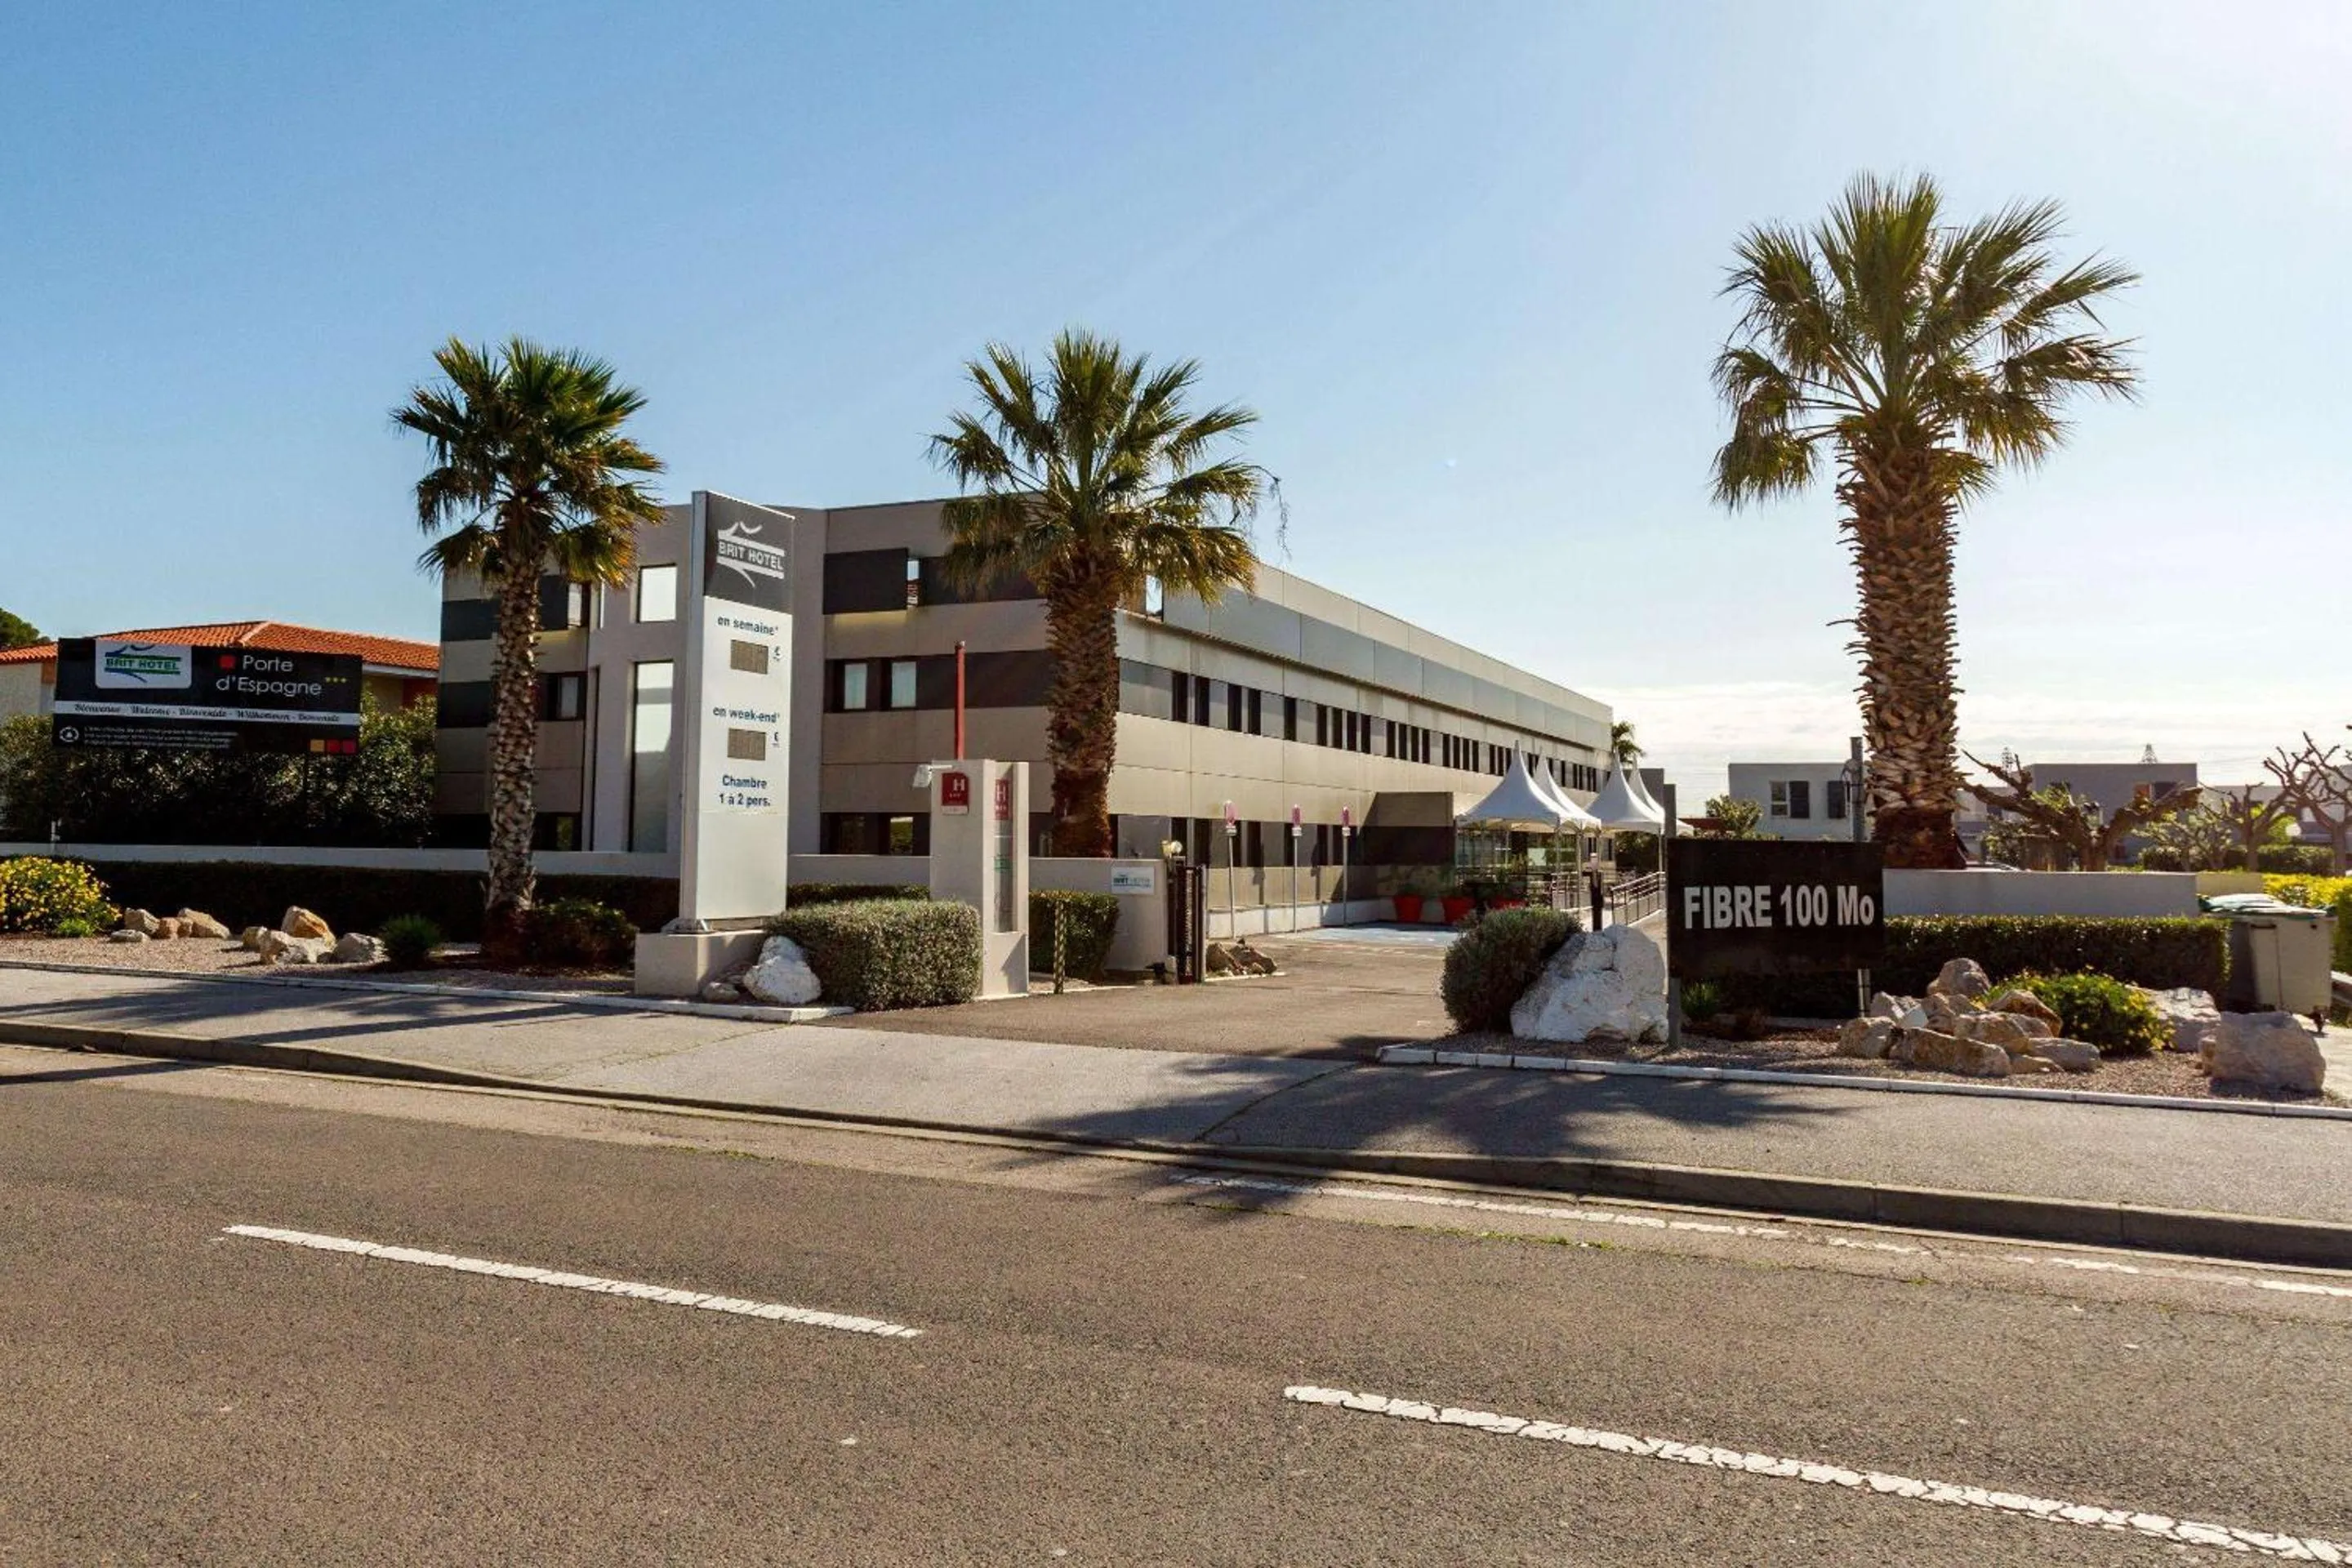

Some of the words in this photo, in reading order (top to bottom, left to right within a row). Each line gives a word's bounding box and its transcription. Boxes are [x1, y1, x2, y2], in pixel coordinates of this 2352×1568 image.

[718, 541, 746, 559] BRIT
[748, 549, 784, 571] HOTEL
[717, 617, 730, 626] en
[105, 657, 136, 668] BRIT
[139, 659, 180, 670] HOTEL
[243, 654, 294, 672] Porte
[216, 675, 322, 697] d'Espagne
[713, 706, 726, 717] en
[722, 774, 768, 789] Chambre
[953, 778, 965, 791] H
[719, 793, 724, 804] 1
[737, 792, 744, 805] 2
[746, 796, 771, 808] pers.
[996, 784, 1007, 802] H
[1684, 885, 1773, 929] FIBRE
[1780, 884, 1829, 927] 100
[1837, 884, 1875, 926] Mo
